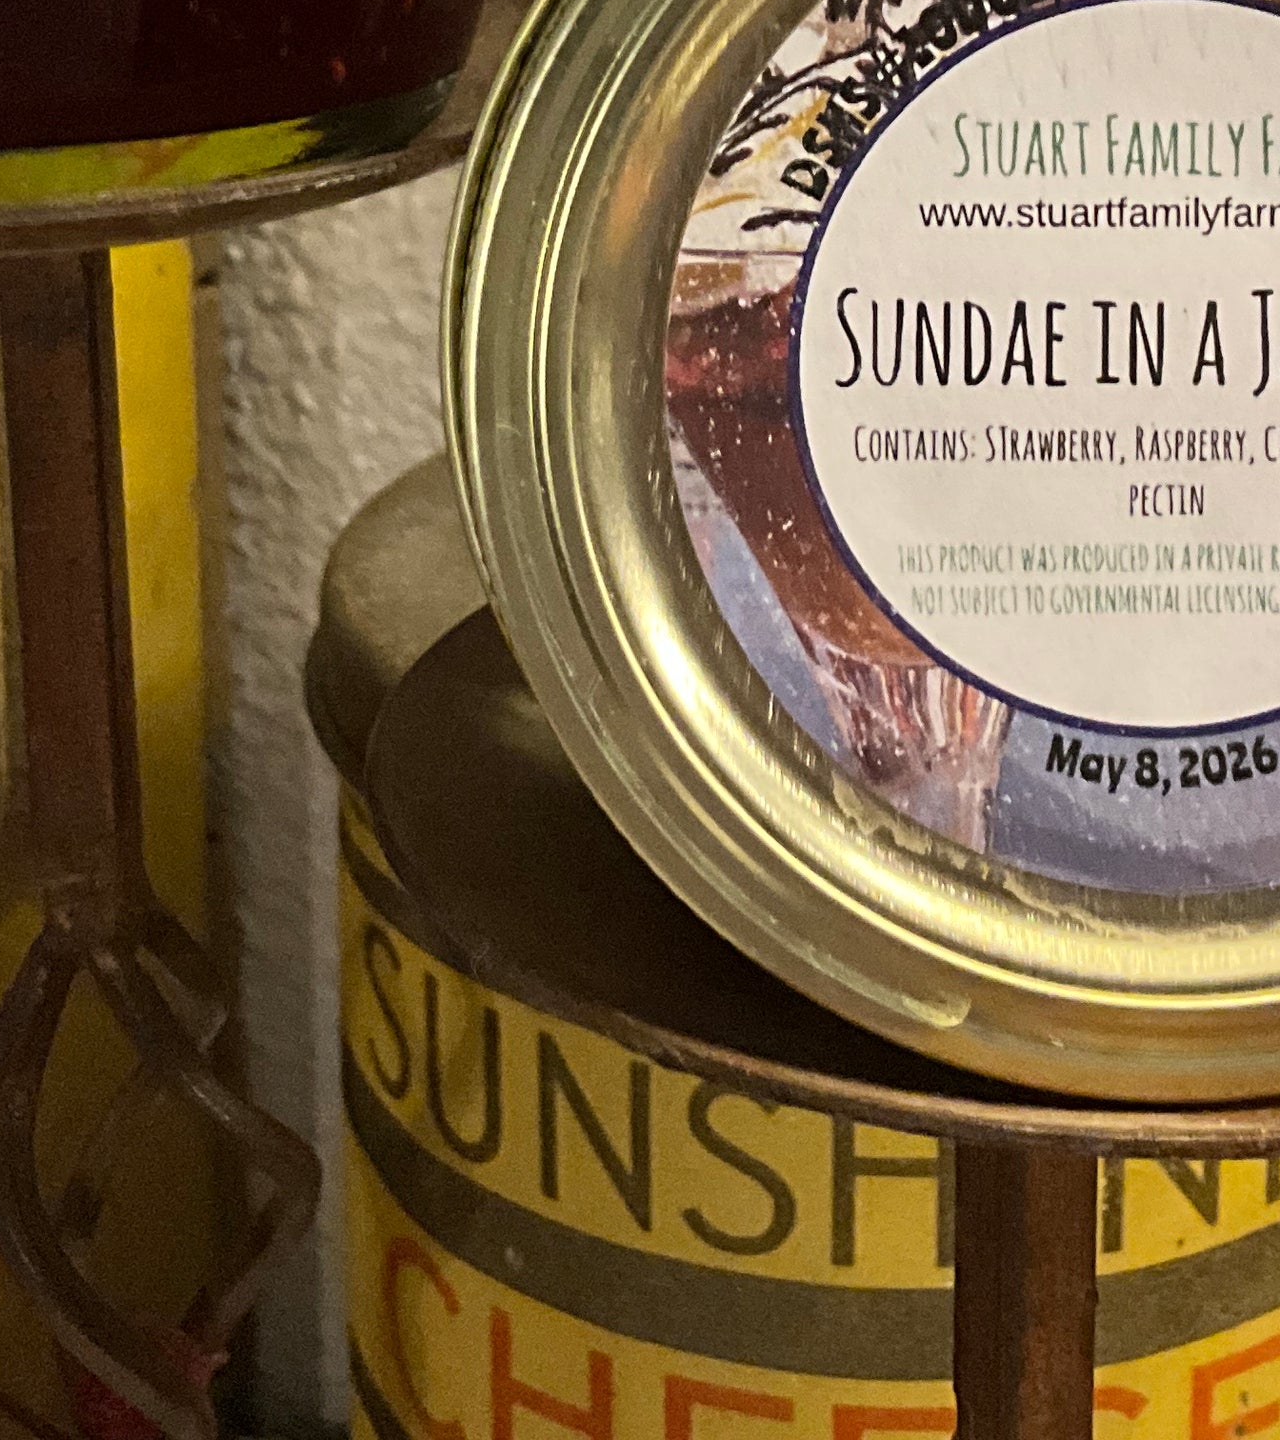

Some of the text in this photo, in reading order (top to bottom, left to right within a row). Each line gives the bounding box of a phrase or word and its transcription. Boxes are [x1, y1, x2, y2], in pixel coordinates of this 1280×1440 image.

[953, 112, 1090, 178] STUART
[1106, 113, 1246, 178] FAMILY
[835, 287, 1068, 388] SUNDAE
[1093, 299, 1165, 387] IN
[1192, 299, 1226, 387] A
[853, 424, 977, 464] CONTAINS:
[984, 424, 1126, 467] STRAWBERRY,
[1134, 425, 1256, 467] RASPBERRY,
[1128, 482, 1206, 518] PECTIN
[897, 543, 935, 574] THIS
[939, 543, 1014, 574] PRODUCT
[1020, 543, 1058, 574] WAS
[1063, 543, 1150, 574] PRODUCED
[1154, 543, 1175, 574] IN
[1181, 543, 1192, 574] A
[1197, 543, 1265, 574] PRIVATE
[911, 584, 944, 616] NOT
[950, 584, 1019, 616] SUBJECT
[1024, 584, 1045, 616] TO
[1050, 584, 1181, 616] GOVERNMENTAL
[1187, 584, 1280, 616] LICENSING
[1045, 732, 1279, 797] May 8, 2026
